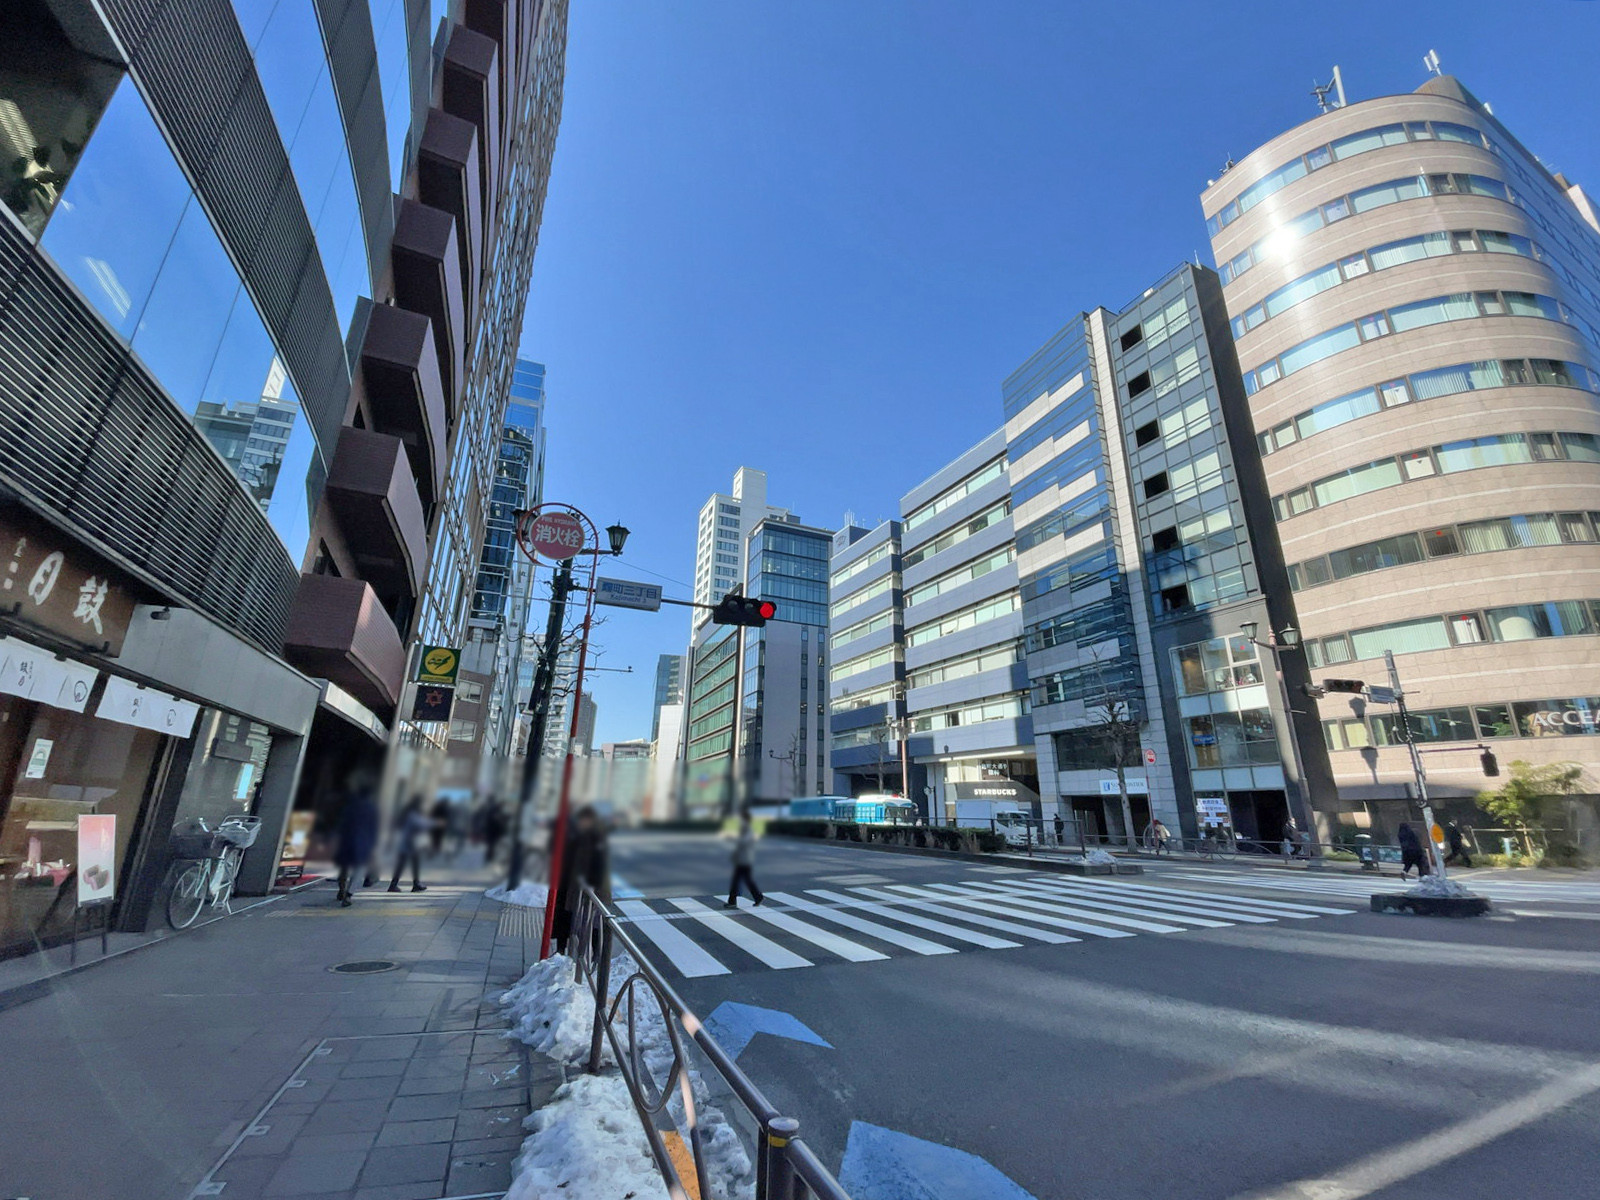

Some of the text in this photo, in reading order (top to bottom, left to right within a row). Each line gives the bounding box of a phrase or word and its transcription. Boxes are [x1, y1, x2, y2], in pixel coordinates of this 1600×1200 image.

[535, 523, 580, 548] 消火栓
[974, 788, 1017, 796] STARBUCKS
